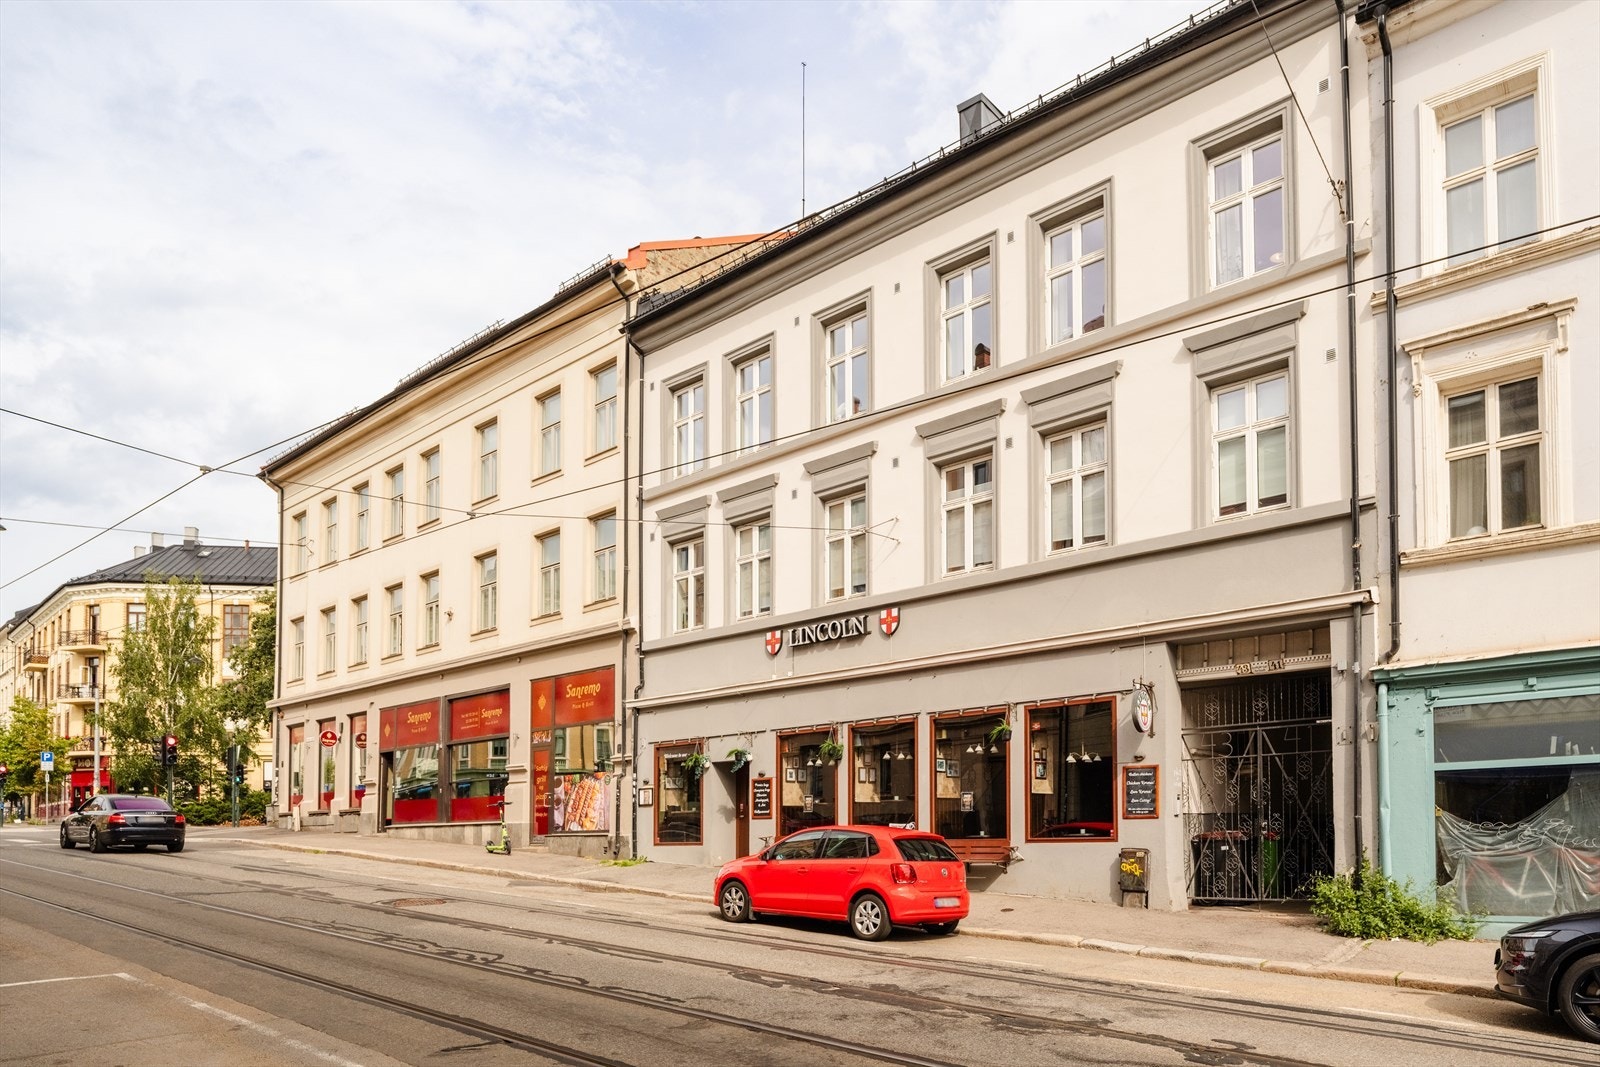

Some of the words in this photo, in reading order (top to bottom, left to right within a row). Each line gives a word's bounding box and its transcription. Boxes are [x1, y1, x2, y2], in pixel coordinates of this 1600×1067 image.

[788, 616, 869, 647] LINCOLN
[1236, 663, 1249, 674] 43
[566, 683, 601, 698] Sanremo
[407, 711, 432, 724] Sanremo
[481, 708, 503, 718] Sanremo
[44, 753, 51, 761] P
